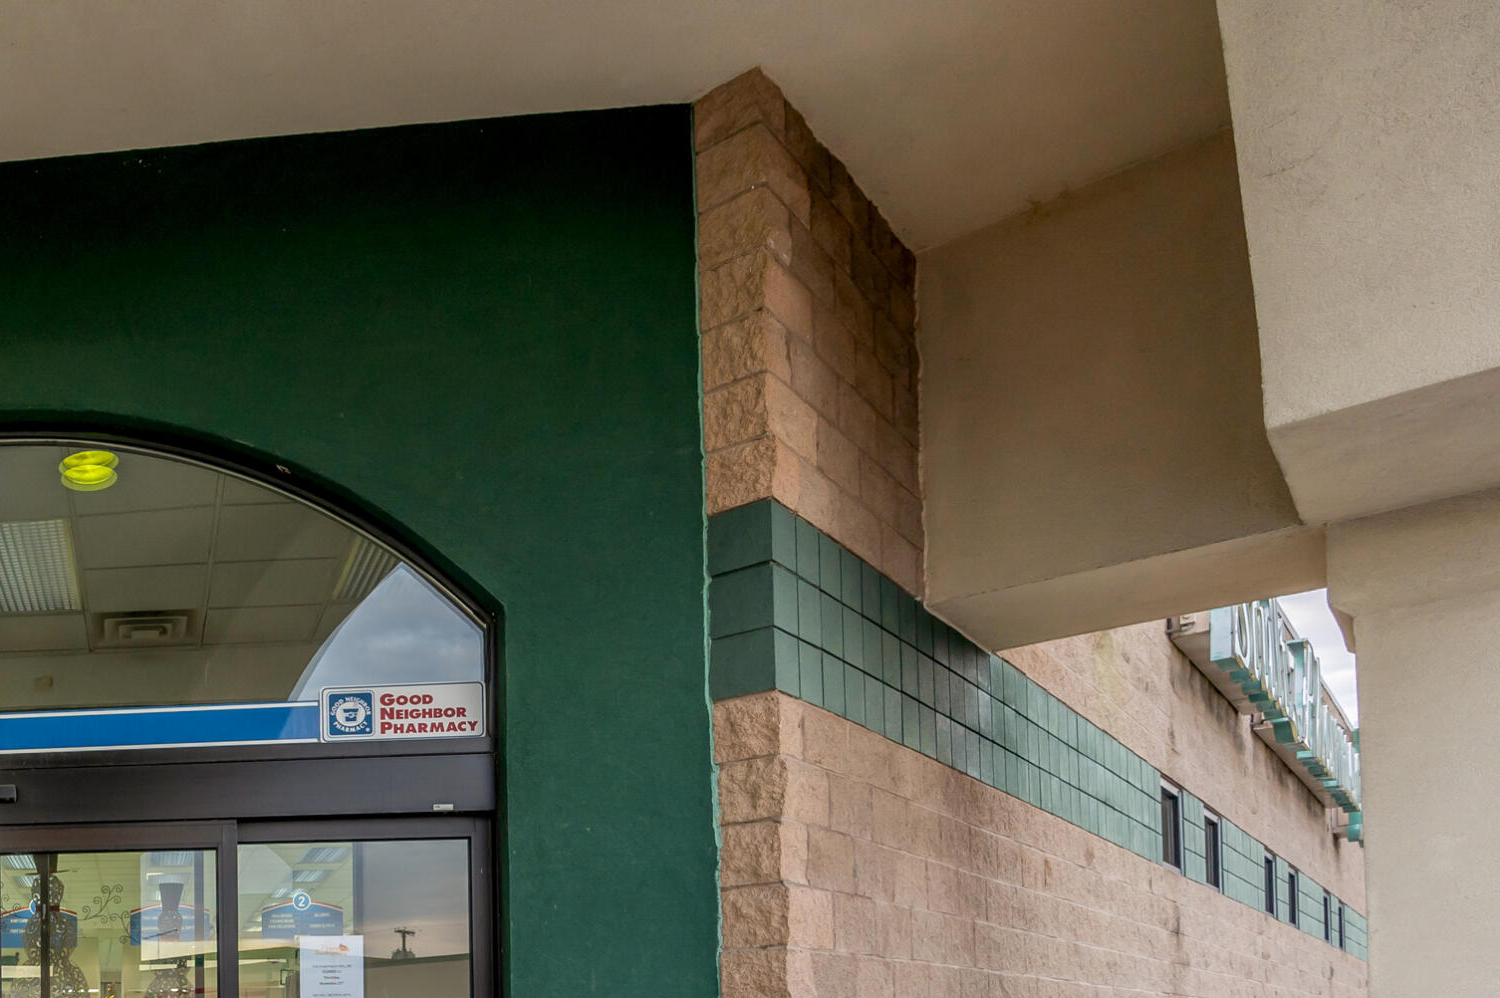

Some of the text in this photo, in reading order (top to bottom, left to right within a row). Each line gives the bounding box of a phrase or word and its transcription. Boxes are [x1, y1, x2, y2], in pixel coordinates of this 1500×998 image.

[380, 693, 434, 706] GOOD
[380, 707, 466, 720] NEIGHBOR
[380, 720, 478, 734] PHARMACY
[298, 896, 306, 907] 2
